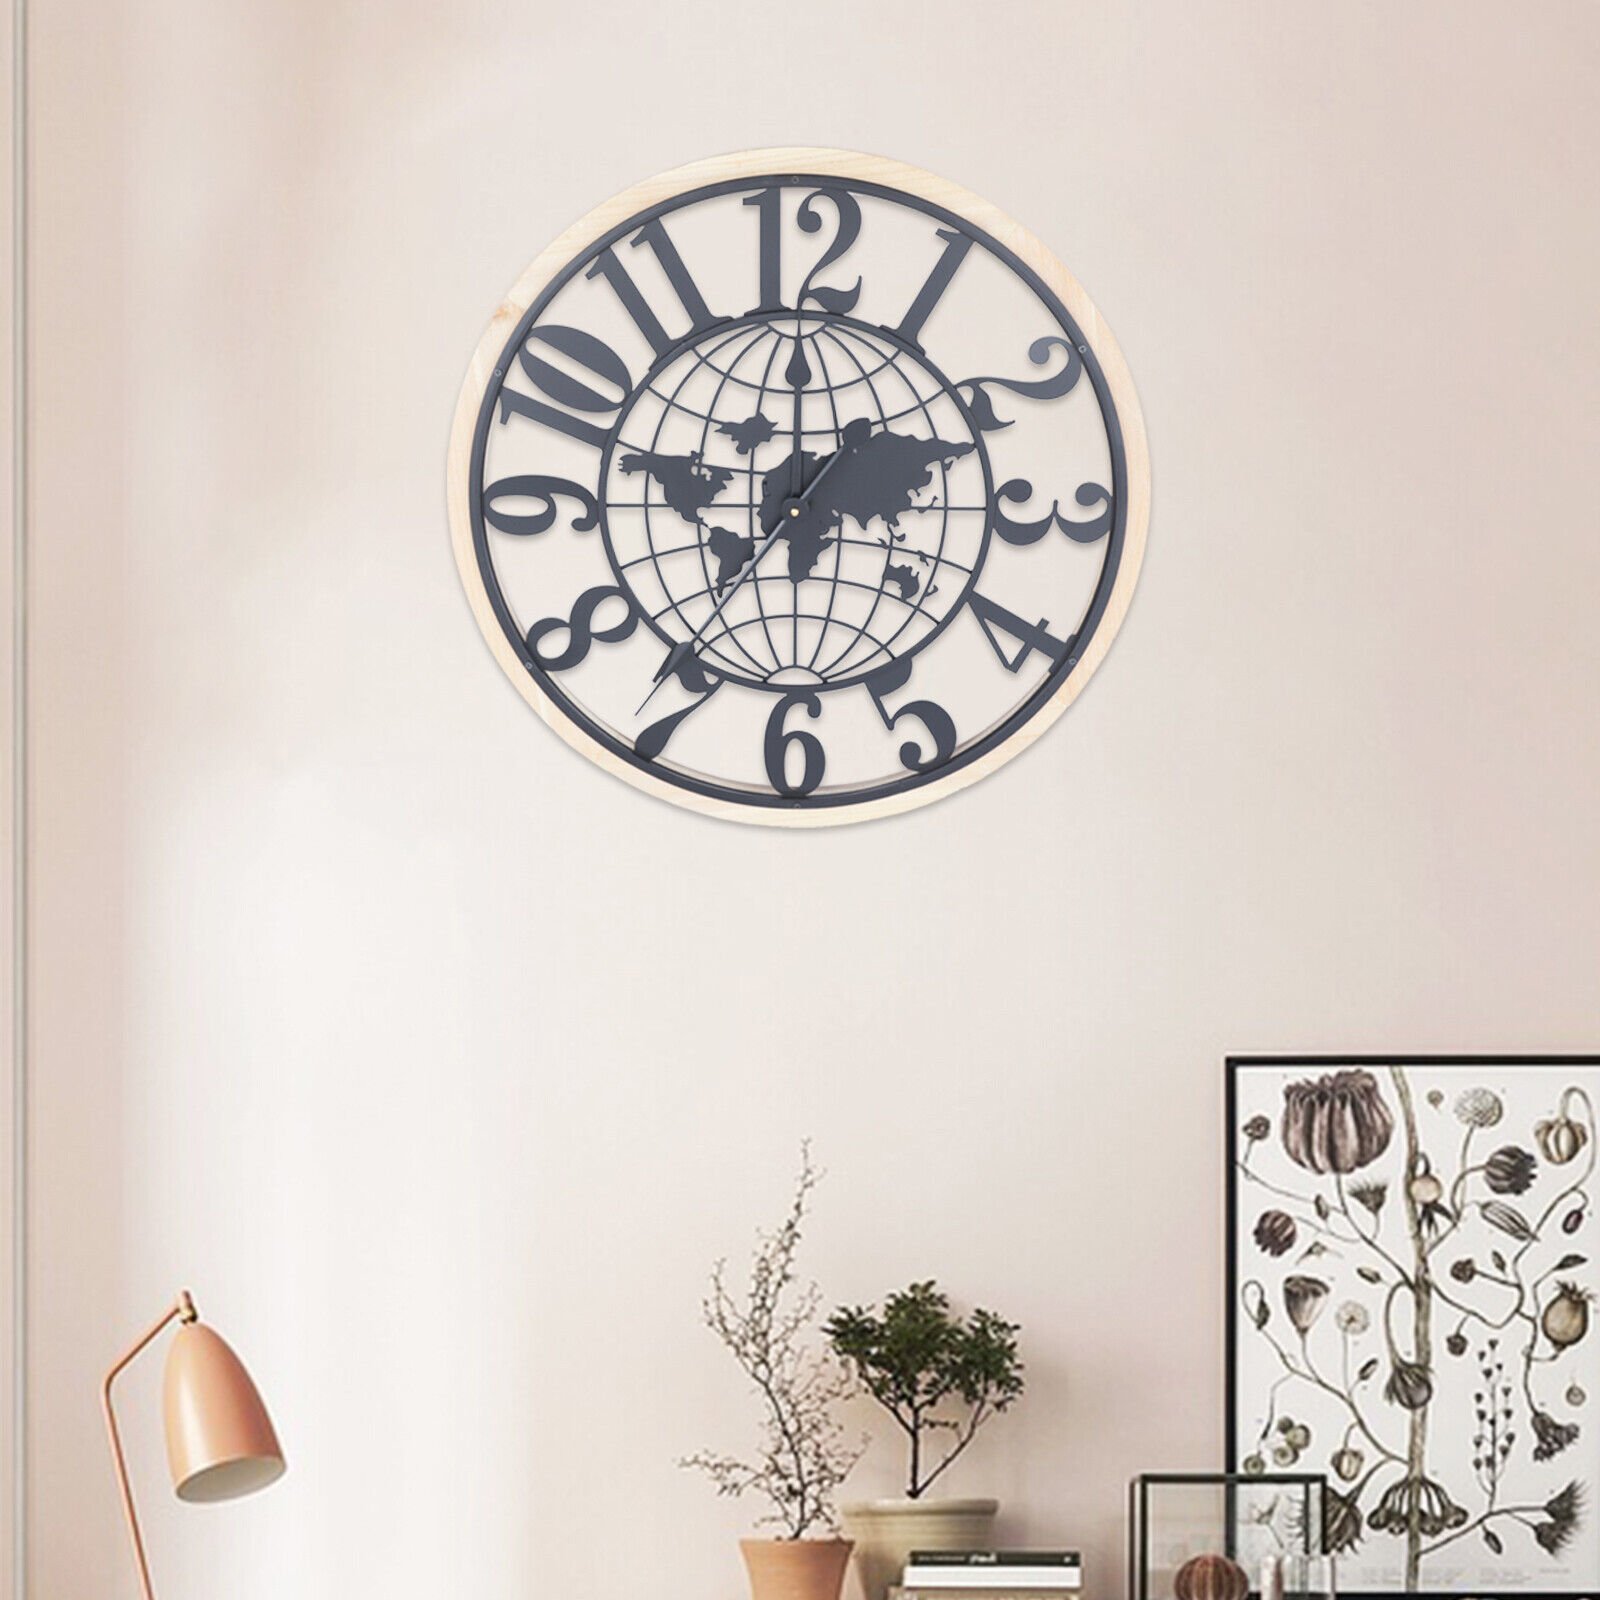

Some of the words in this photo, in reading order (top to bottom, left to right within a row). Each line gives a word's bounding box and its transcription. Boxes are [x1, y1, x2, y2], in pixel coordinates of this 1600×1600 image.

[585, 222, 732, 371] 11
[742, 187, 863, 315] 12
[879, 227, 974, 356] 1
[498, 324, 634, 449] 10
[953, 335, 1083, 431] 2
[483, 474, 599, 537] 9
[992, 478, 1113, 546] 3
[528, 583, 640, 672] 8
[965, 588, 1077, 674] 4
[634, 648, 724, 762] 7
[764, 691, 826, 798] 6
[866, 657, 957, 773] 5
